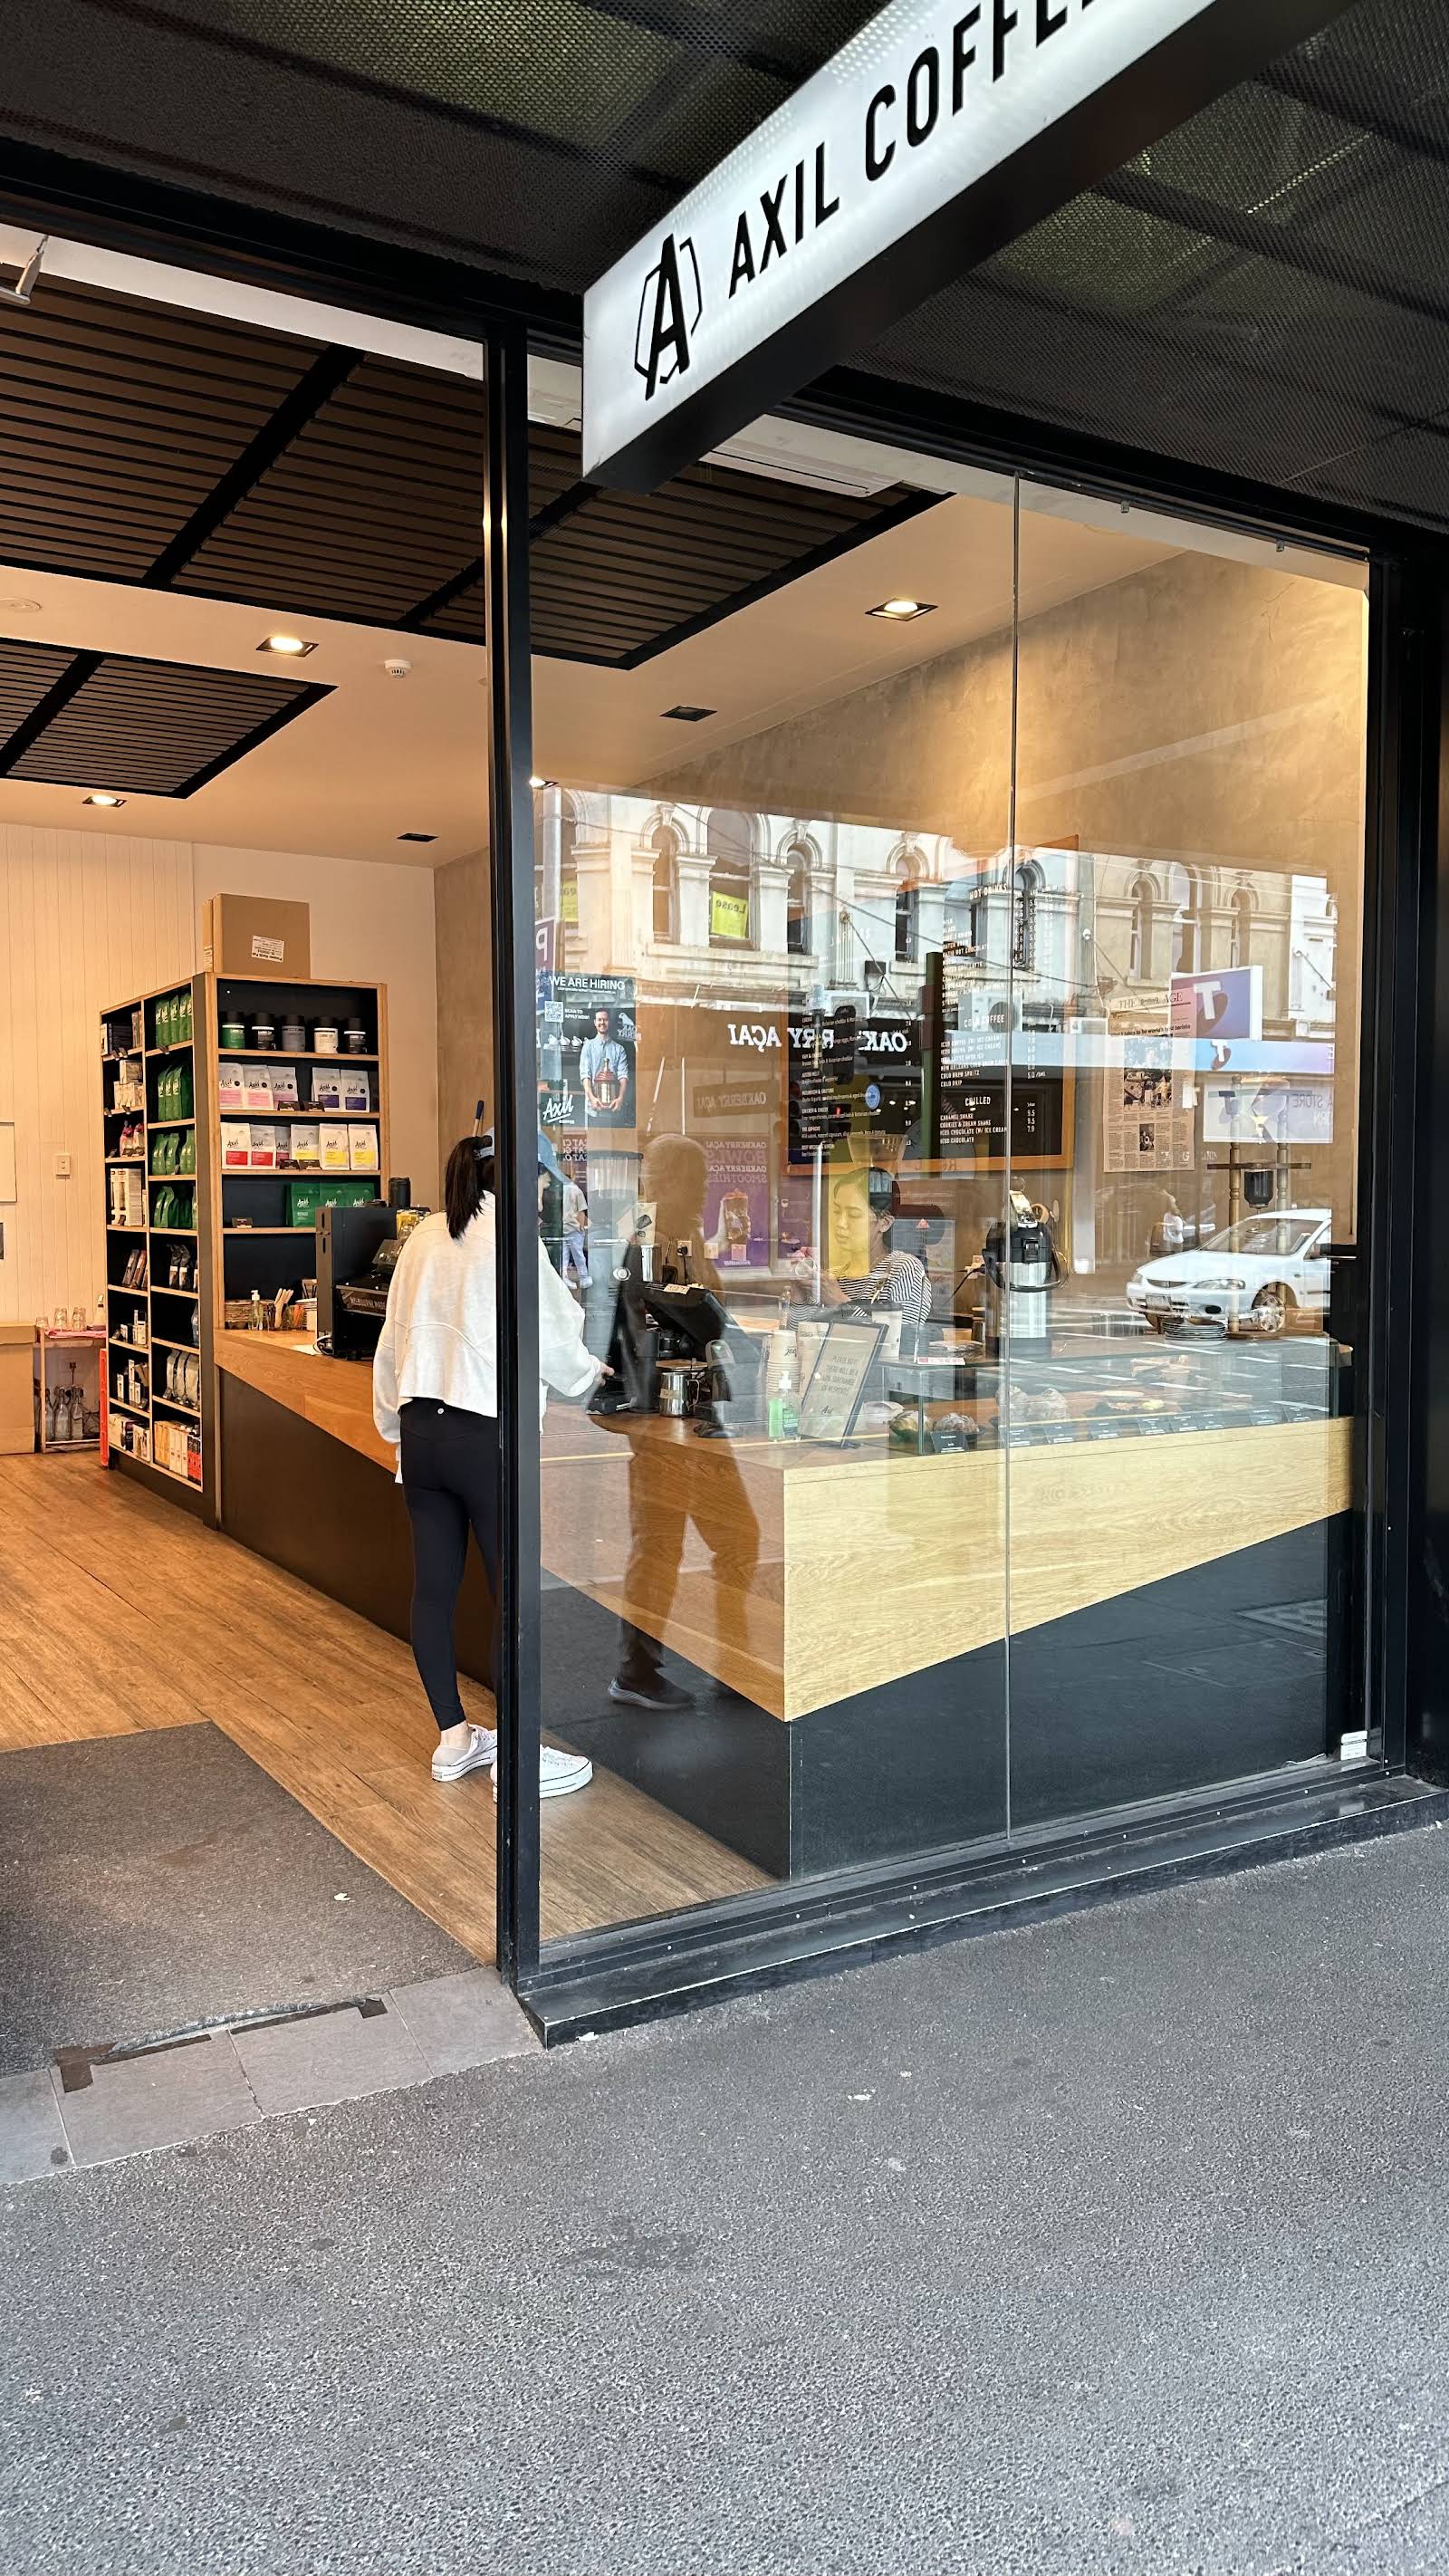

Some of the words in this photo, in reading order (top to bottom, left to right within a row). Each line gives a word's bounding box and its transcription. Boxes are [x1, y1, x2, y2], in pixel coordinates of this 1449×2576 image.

[729, 141, 840, 300] AXIL
[549, 976, 566, 986] WE
[567, 977, 589, 988] ARE
[590, 978, 626, 990] HIRING
[950, 1128, 974, 1136] CHOCOLATE
